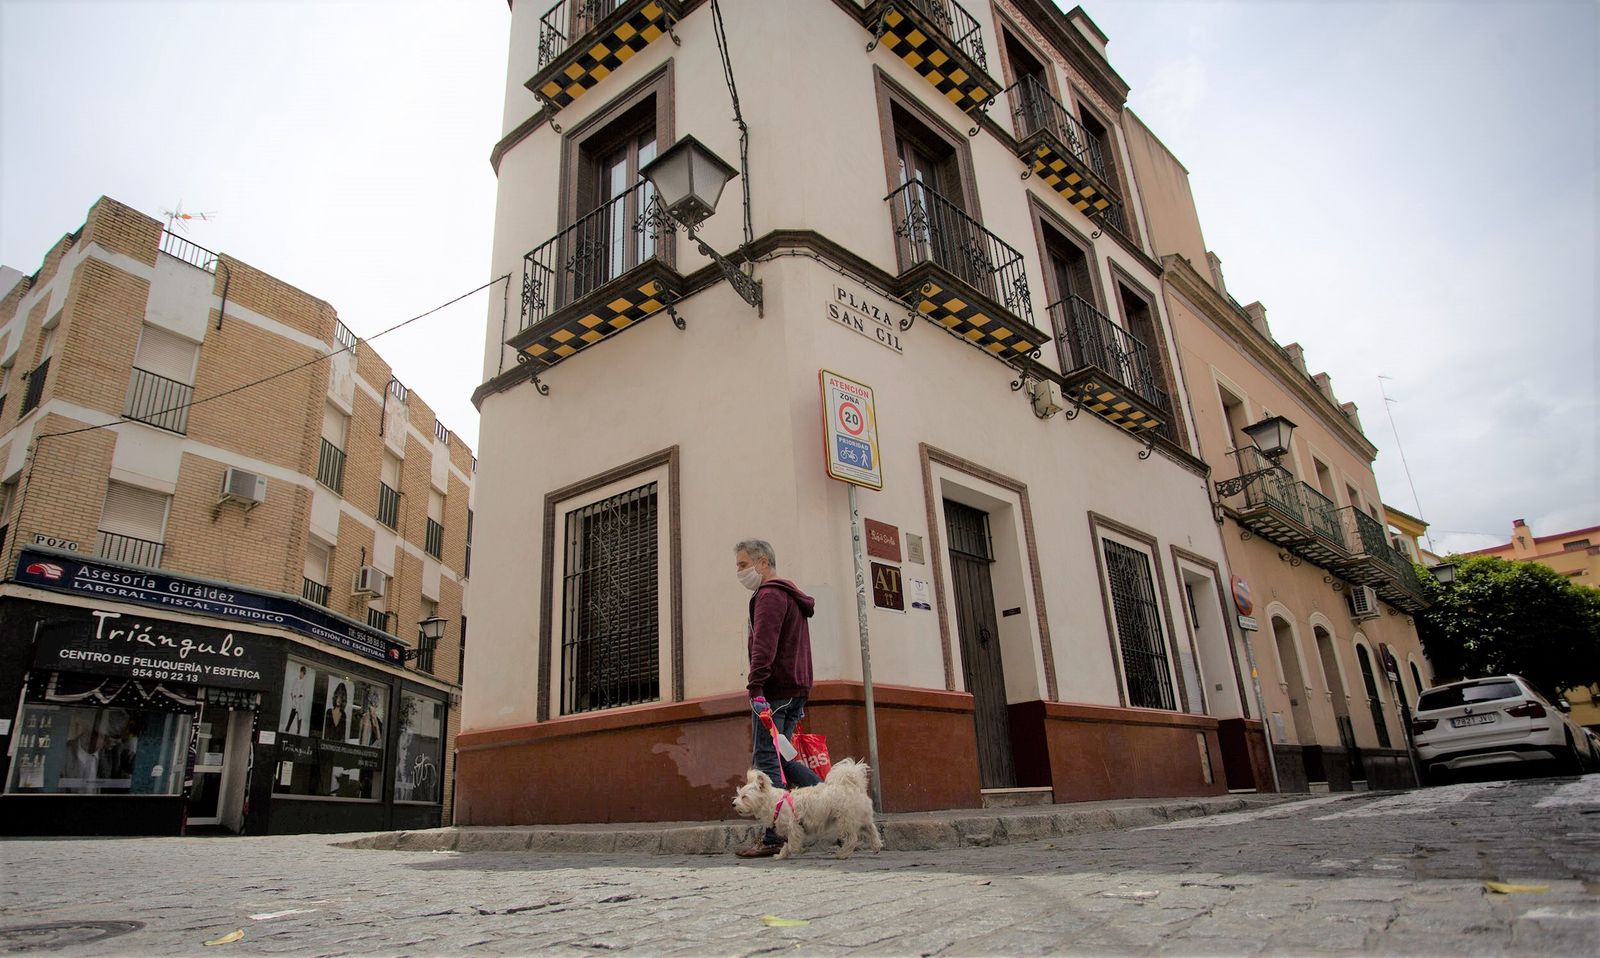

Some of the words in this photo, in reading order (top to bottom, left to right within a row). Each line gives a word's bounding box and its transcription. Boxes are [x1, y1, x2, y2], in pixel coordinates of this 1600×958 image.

[837, 287, 893, 326] PLAZA
[829, 303, 864, 332] SAN
[876, 327, 903, 351] GIL
[829, 378, 870, 399] ATENCIÓN
[839, 392, 860, 405] ZONA
[844, 411, 859, 425] 20
[838, 436, 869, 451] PRIORIDAD
[36, 535, 78, 551] POZO
[77, 565, 156, 589] Asesoría
[169, 582, 235, 603] Giráldez
[874, 567, 900, 593] AT
[73, 581, 147, 600] LABORAL
[162, 596, 210, 610] FISCAL
[223, 606, 284, 622] JURIDICO
[92, 610, 245, 659] Triángulo
[311, 627, 341, 642] GESTIÓN
[341, 638, 350, 646] DE
[352, 642, 385, 659] ESCRITURAS
[59, 649, 112, 663] CENTRO
[114, 656, 130, 665] DE
[132, 657, 202, 673] PELUQUERÍA
[204, 666, 211, 674] Y
[213, 665, 260, 679] ESTÉTICA
[132, 668, 153, 678] 954
[154, 671, 168, 680] 90
[170, 672, 184, 682] 22
[186, 674, 198, 682] 13
